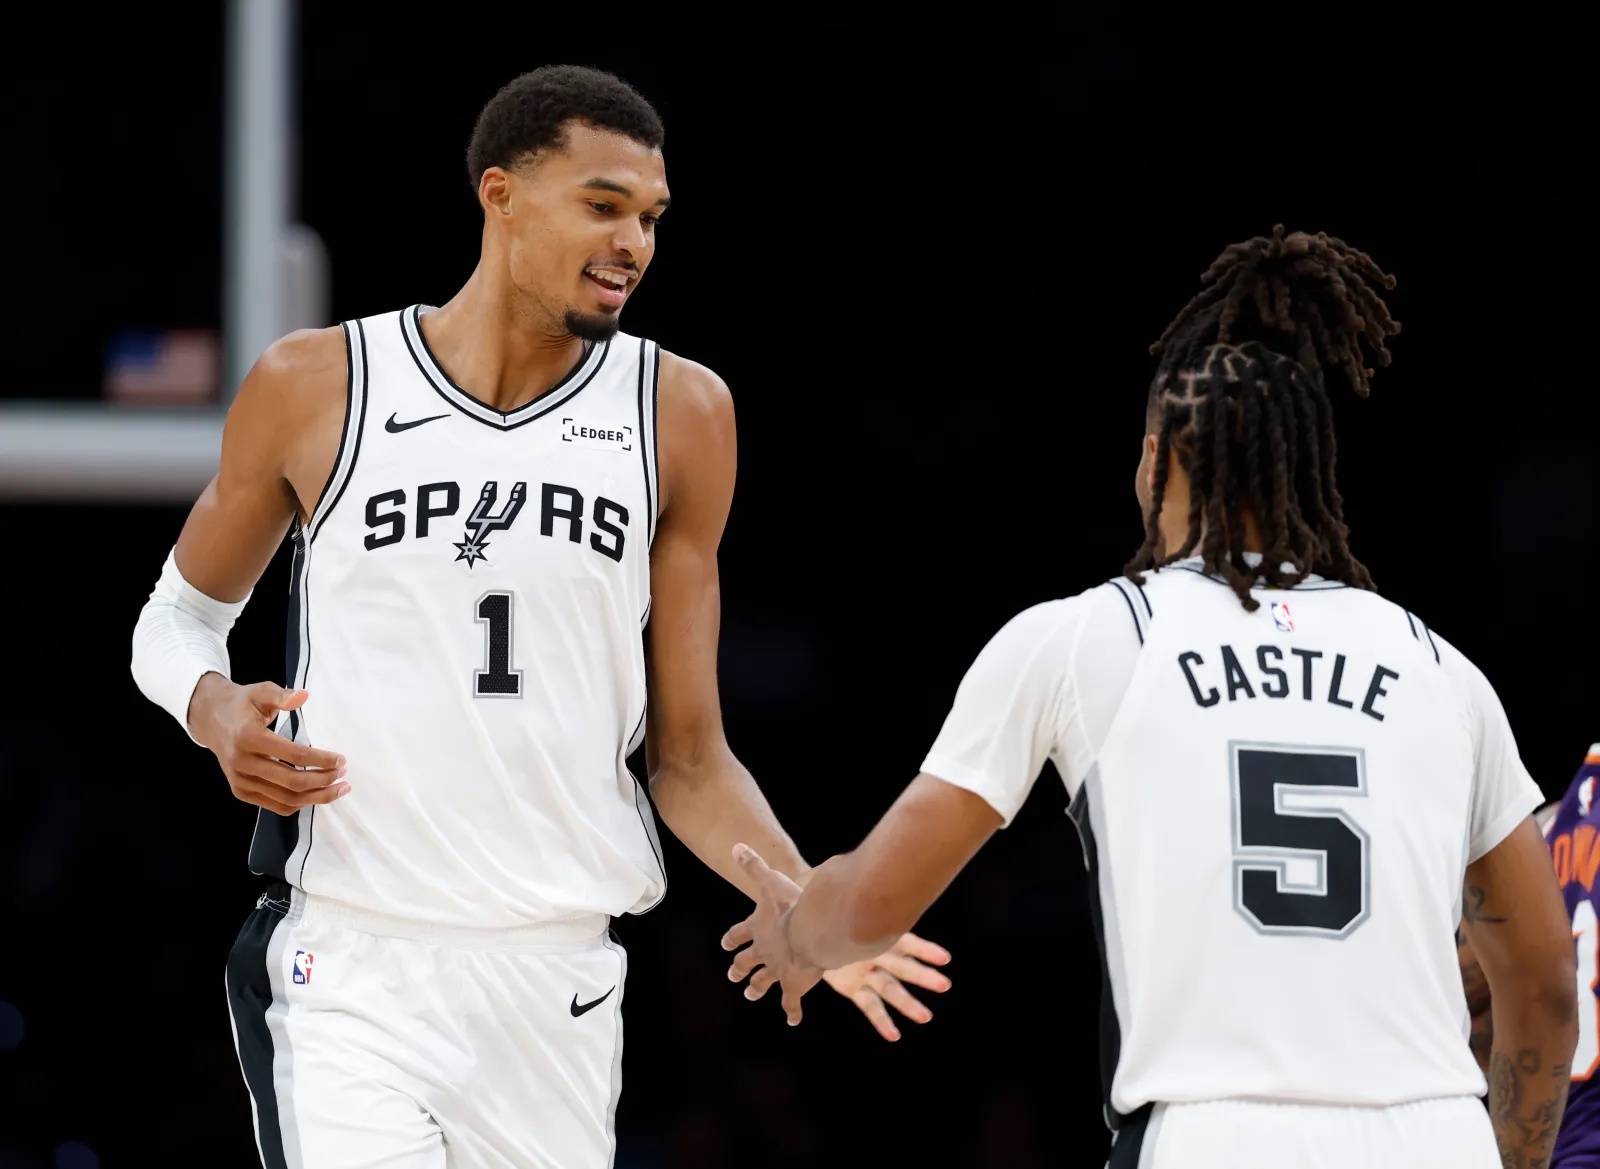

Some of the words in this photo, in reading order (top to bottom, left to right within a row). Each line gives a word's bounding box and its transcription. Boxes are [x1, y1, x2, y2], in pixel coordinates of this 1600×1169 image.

[572, 425, 624, 442] LEDGER
[364, 481, 629, 569] SPURS
[473, 590, 523, 698] 1
[1178, 645, 1399, 721] CASTLE
[1228, 740, 1371, 940] 5
